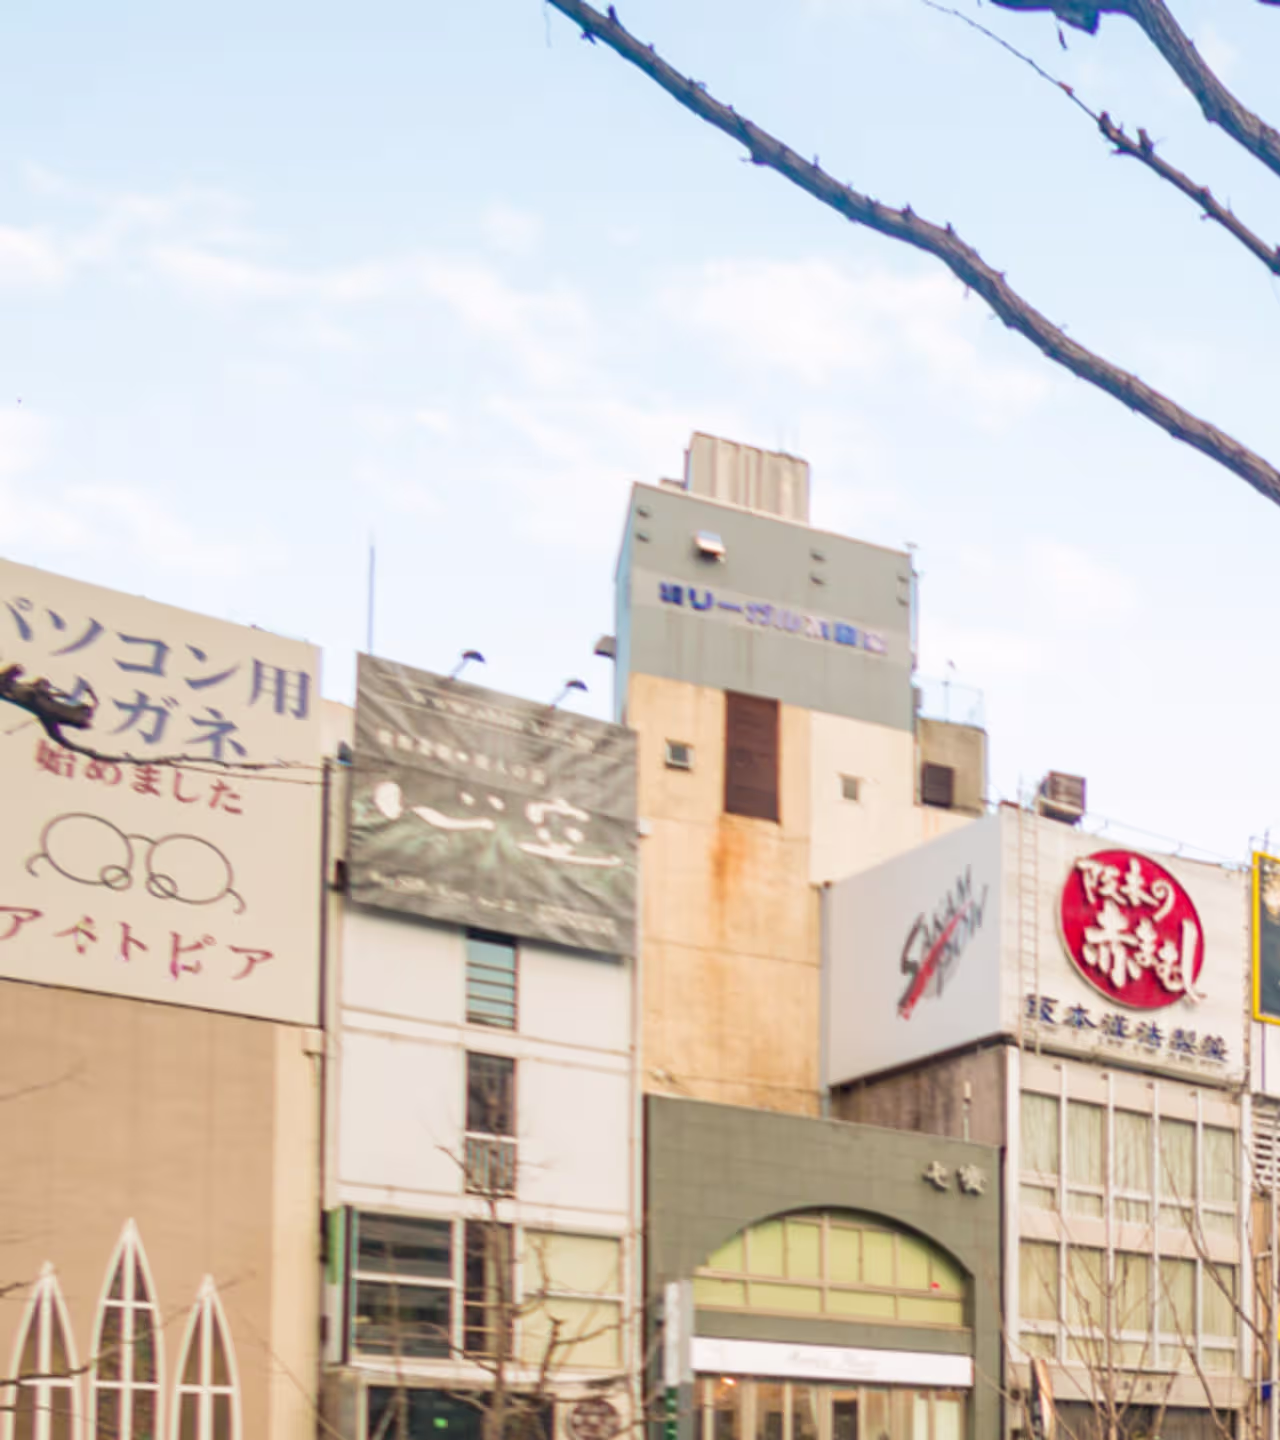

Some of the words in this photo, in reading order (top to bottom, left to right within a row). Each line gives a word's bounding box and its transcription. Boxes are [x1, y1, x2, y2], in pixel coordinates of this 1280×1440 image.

[66, 674, 248, 760] ガネ
[34, 737, 244, 816] 始めました
